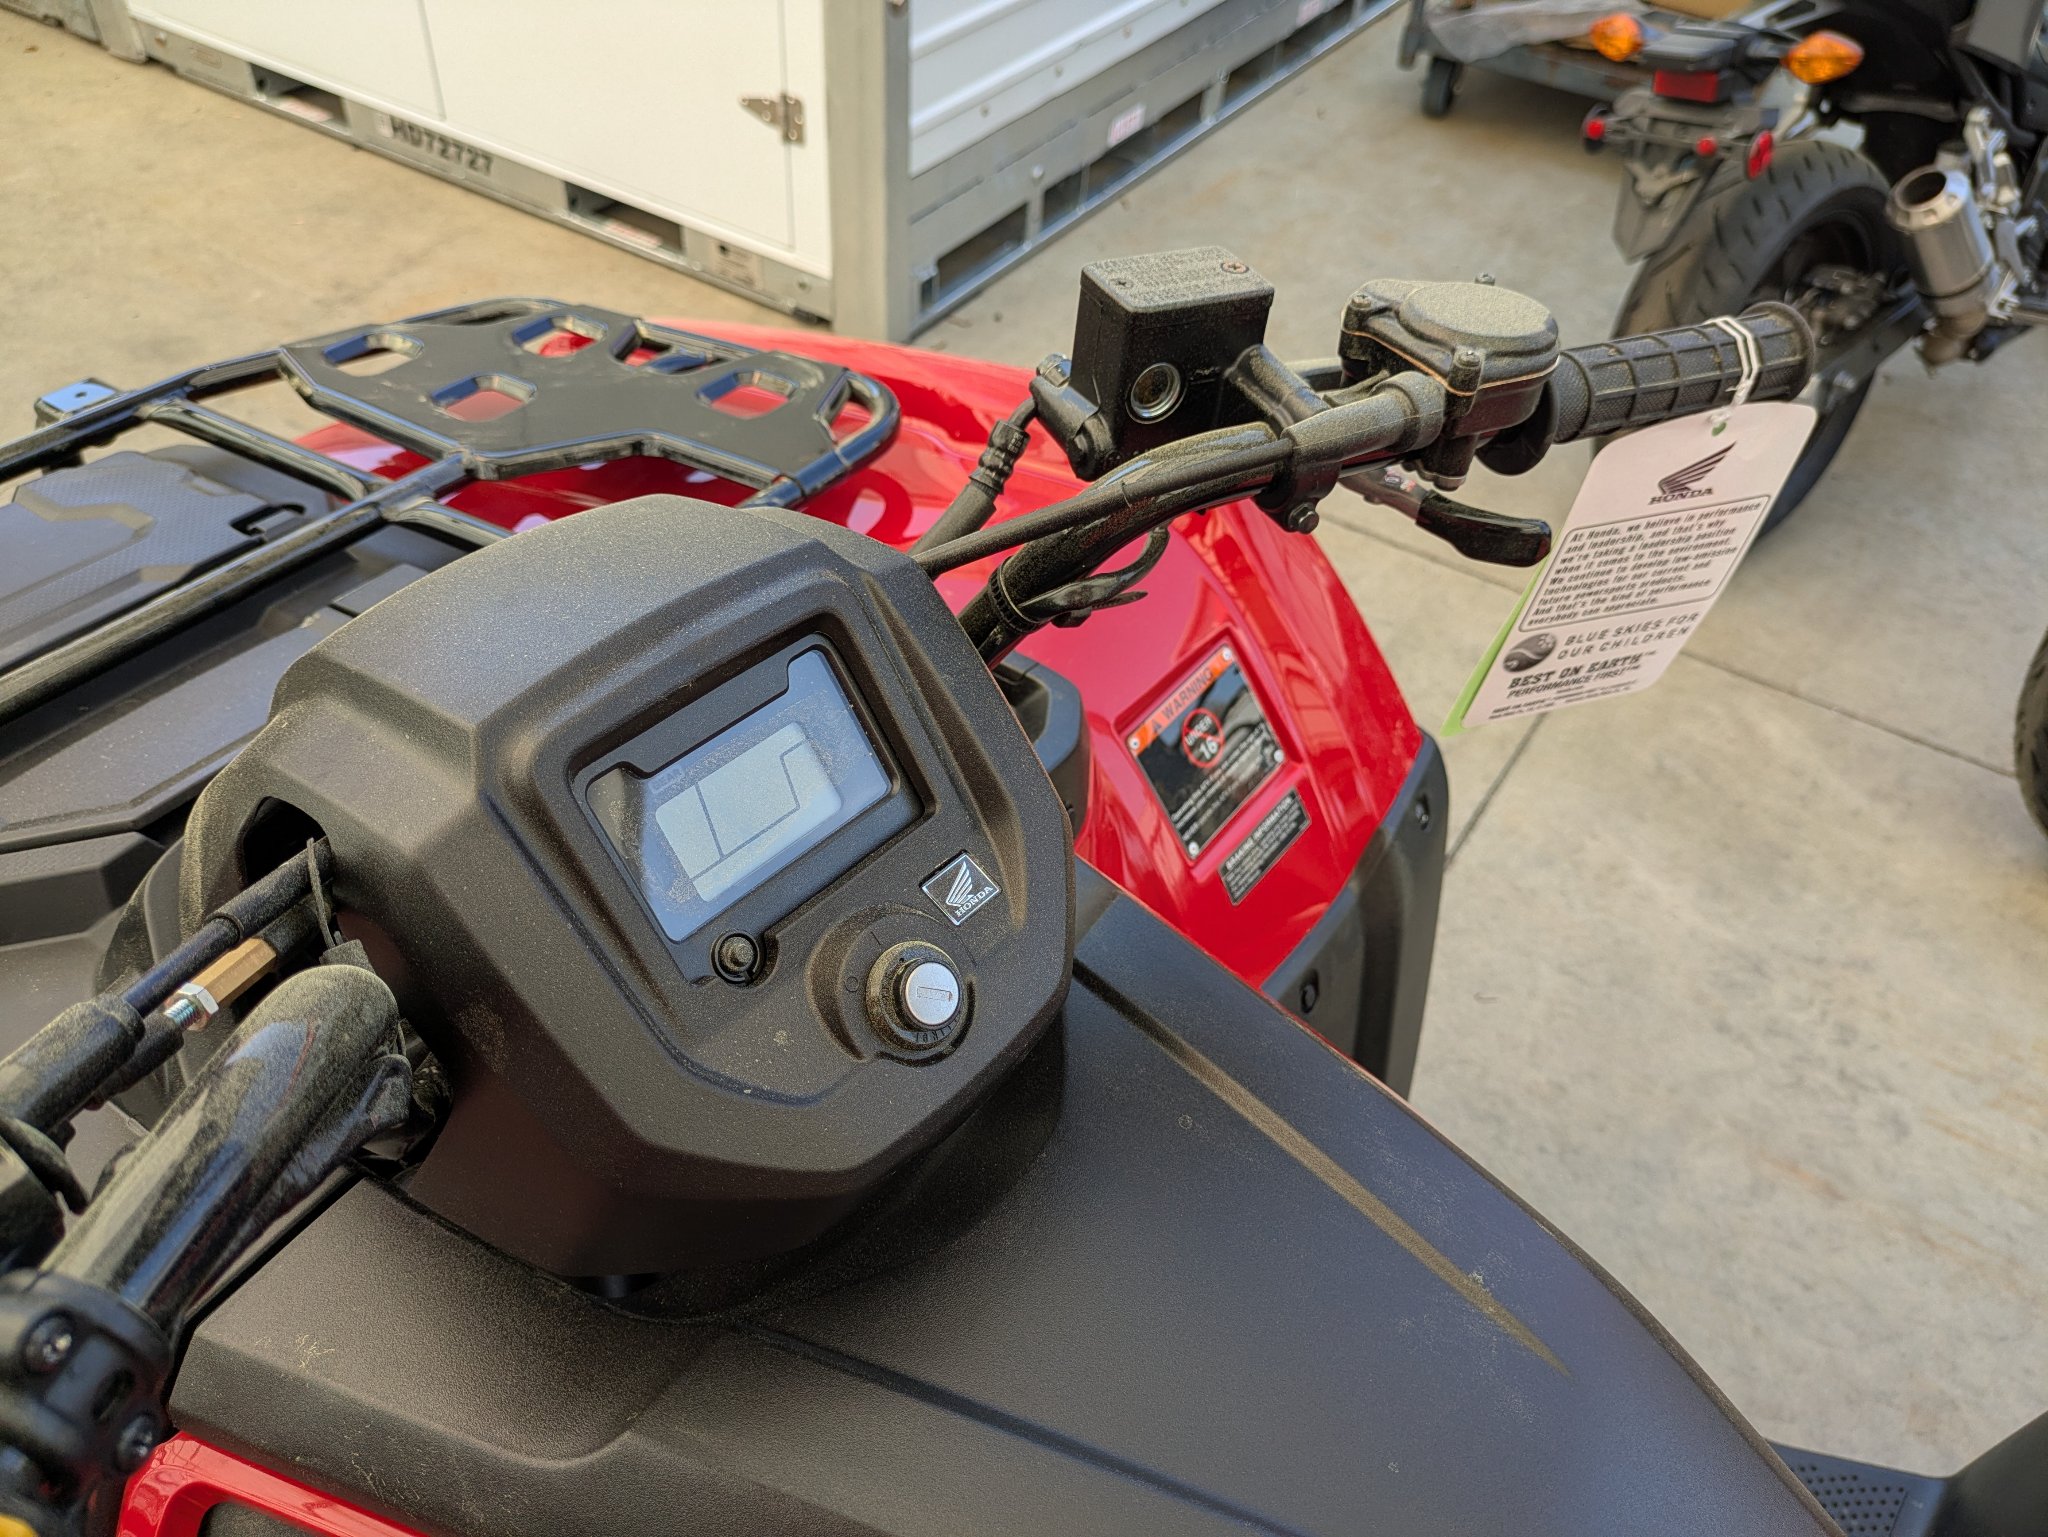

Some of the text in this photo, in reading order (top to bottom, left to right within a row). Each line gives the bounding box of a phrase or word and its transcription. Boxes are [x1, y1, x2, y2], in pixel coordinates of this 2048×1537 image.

[1649, 488, 1713, 505] HONDA
[1564, 519, 1726, 554] and leadership, and that's why
[1569, 502, 1761, 543] At Honda, we believe in performance
[1554, 537, 1730, 575] when it comes to the environment.
[1559, 553, 1590, 564] we're
[1592, 546, 1626, 559] taking
[1638, 535, 1692, 550] leadership
[1693, 527, 1736, 541] position
[1543, 559, 1712, 596] technologies for our current and
[1549, 546, 1737, 585] We continue to develop low-emission
[1532, 579, 1711, 616] And that's the kind of performance
[1537, 574, 1685, 606] future powersports products.
[1527, 597, 1658, 626] everybody can appreciate.
[1557, 626, 1690, 660] OUR CHILDREN
[1564, 612, 1699, 646] BLUE SKIES FOR
[1162, 667, 1214, 720] WARNING
[1507, 675, 1593, 698] PERFORMANCE
[1508, 670, 1556, 689] BEST
[1558, 665, 1583, 679] ON
[1184, 715, 1213, 746] UNDER
[1198, 736, 1220, 761] 16
[955, 886, 994, 918] HONDA
